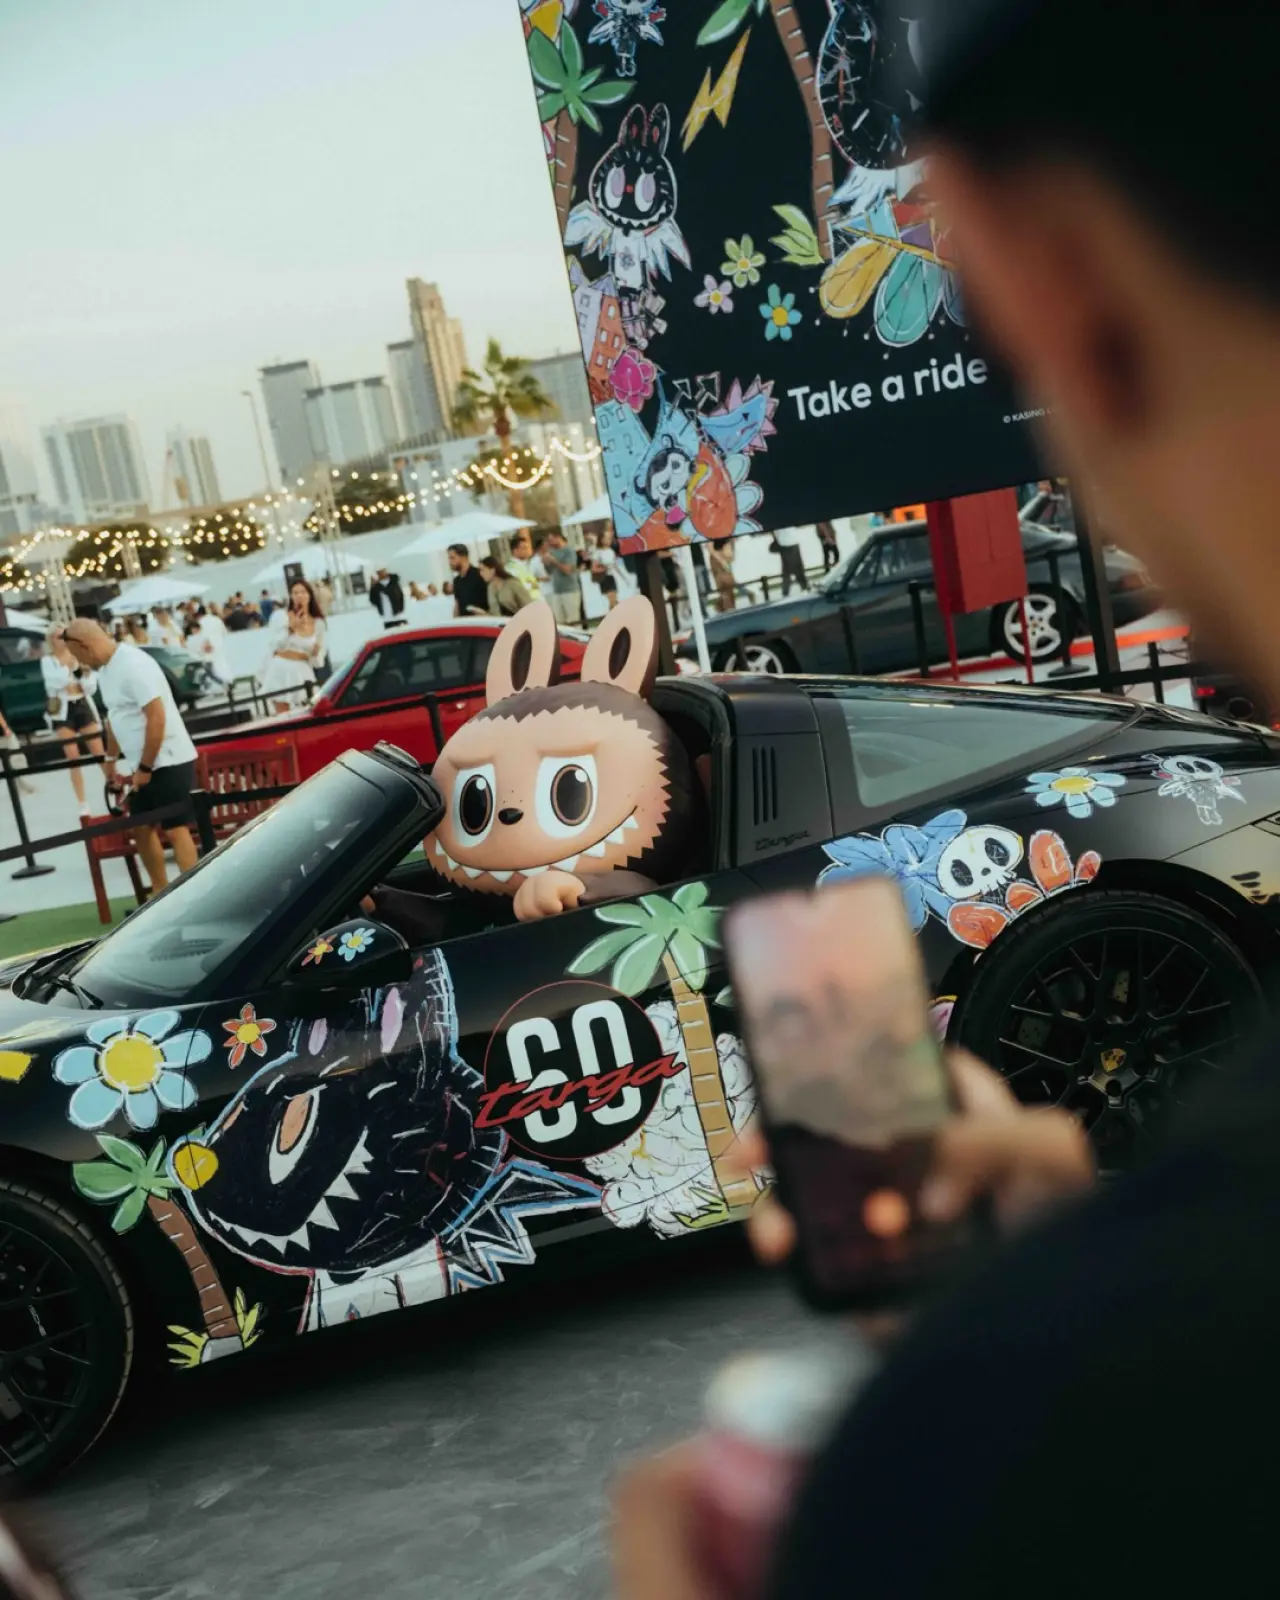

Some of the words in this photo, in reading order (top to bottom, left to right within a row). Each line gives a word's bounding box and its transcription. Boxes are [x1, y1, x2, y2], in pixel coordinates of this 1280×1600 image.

[787, 380, 872, 420] Take
[881, 375, 905, 402] a
[914, 353, 988, 396] ride
[1012, 408, 1045, 422] KASING
[474, 1052, 687, 1128] targa
[506, 1000, 642, 1143] 60
